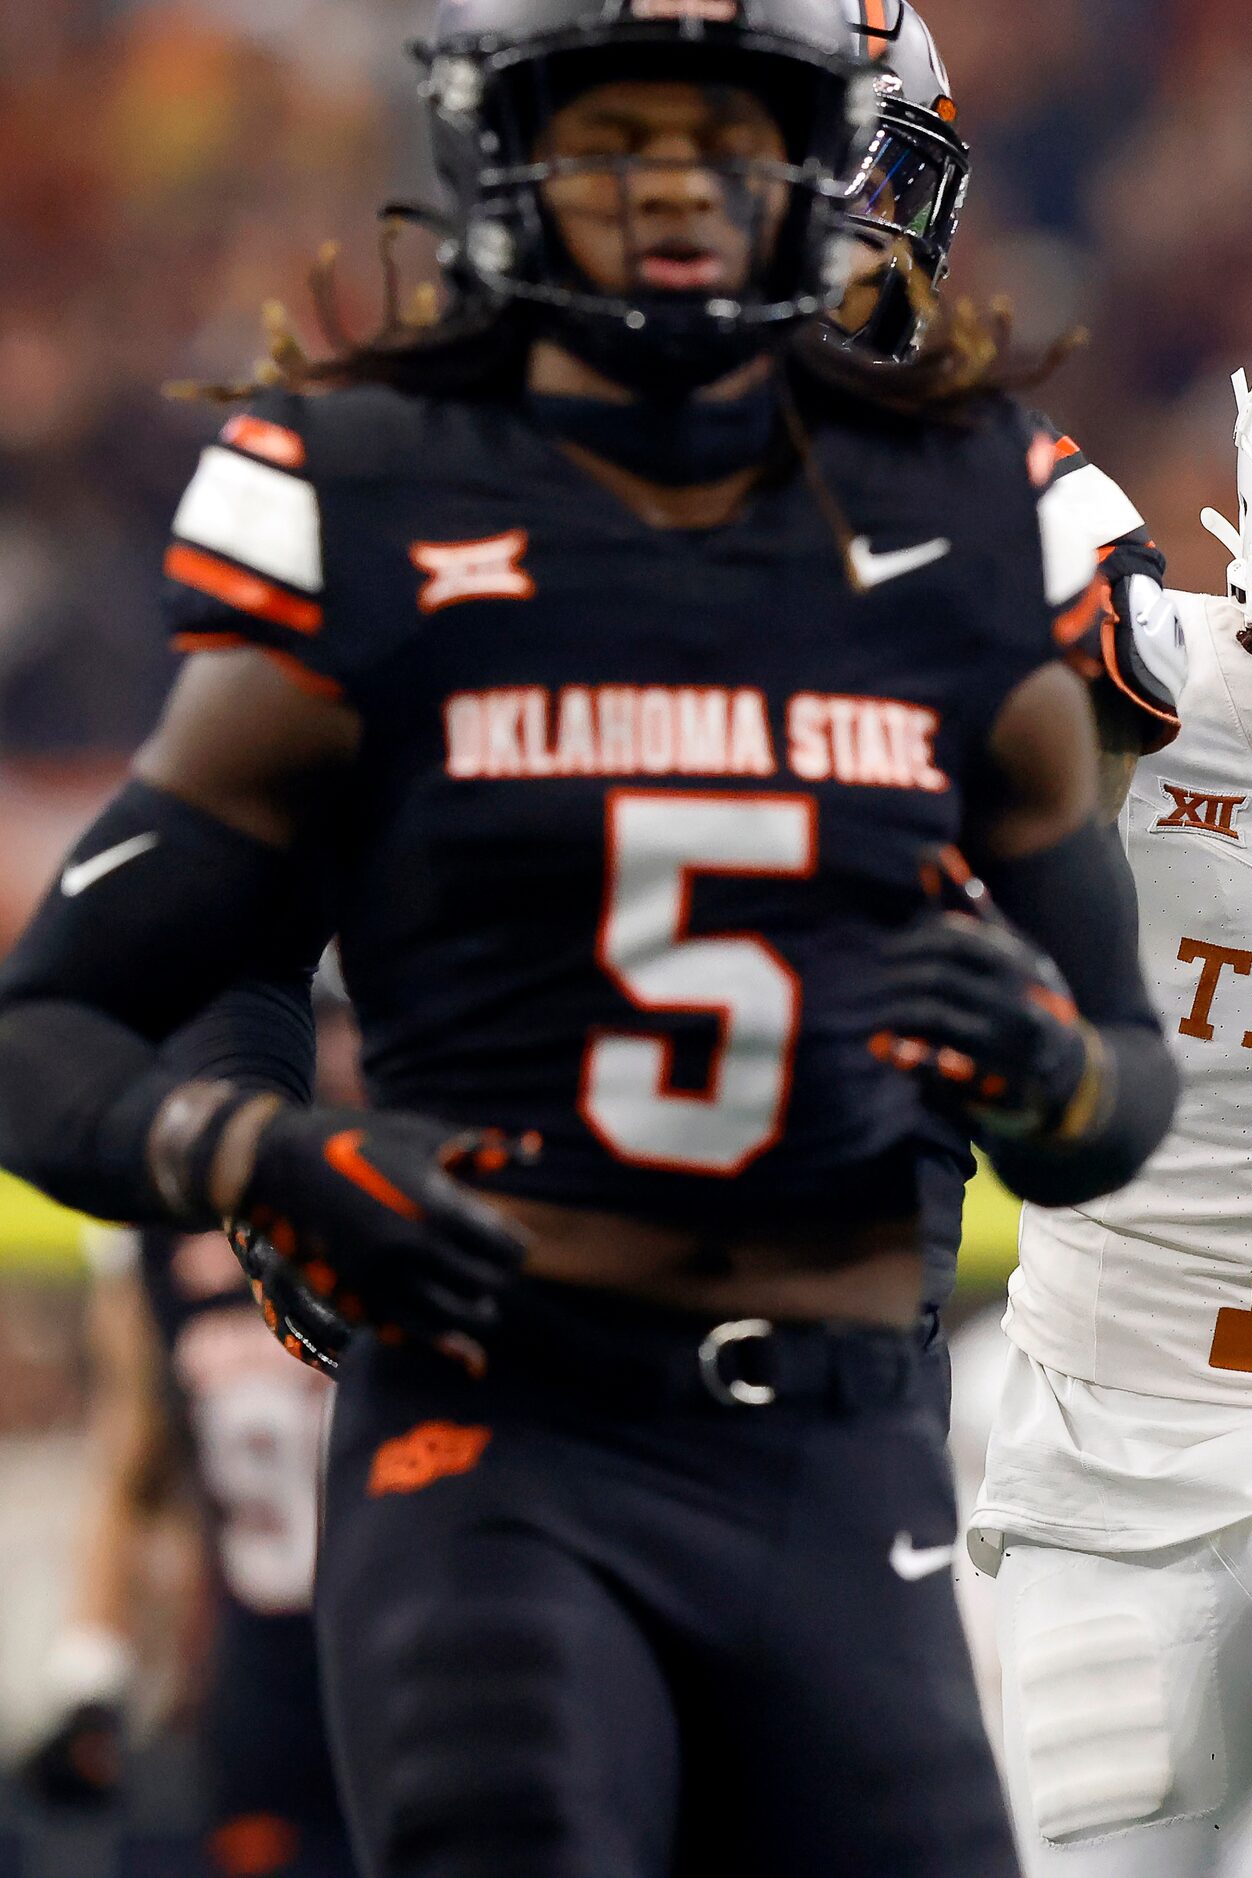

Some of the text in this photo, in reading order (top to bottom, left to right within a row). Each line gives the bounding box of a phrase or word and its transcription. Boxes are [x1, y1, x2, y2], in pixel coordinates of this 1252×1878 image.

[443, 683, 951, 793] OKLAHOMA STATE
[577, 786, 820, 1179] 5
